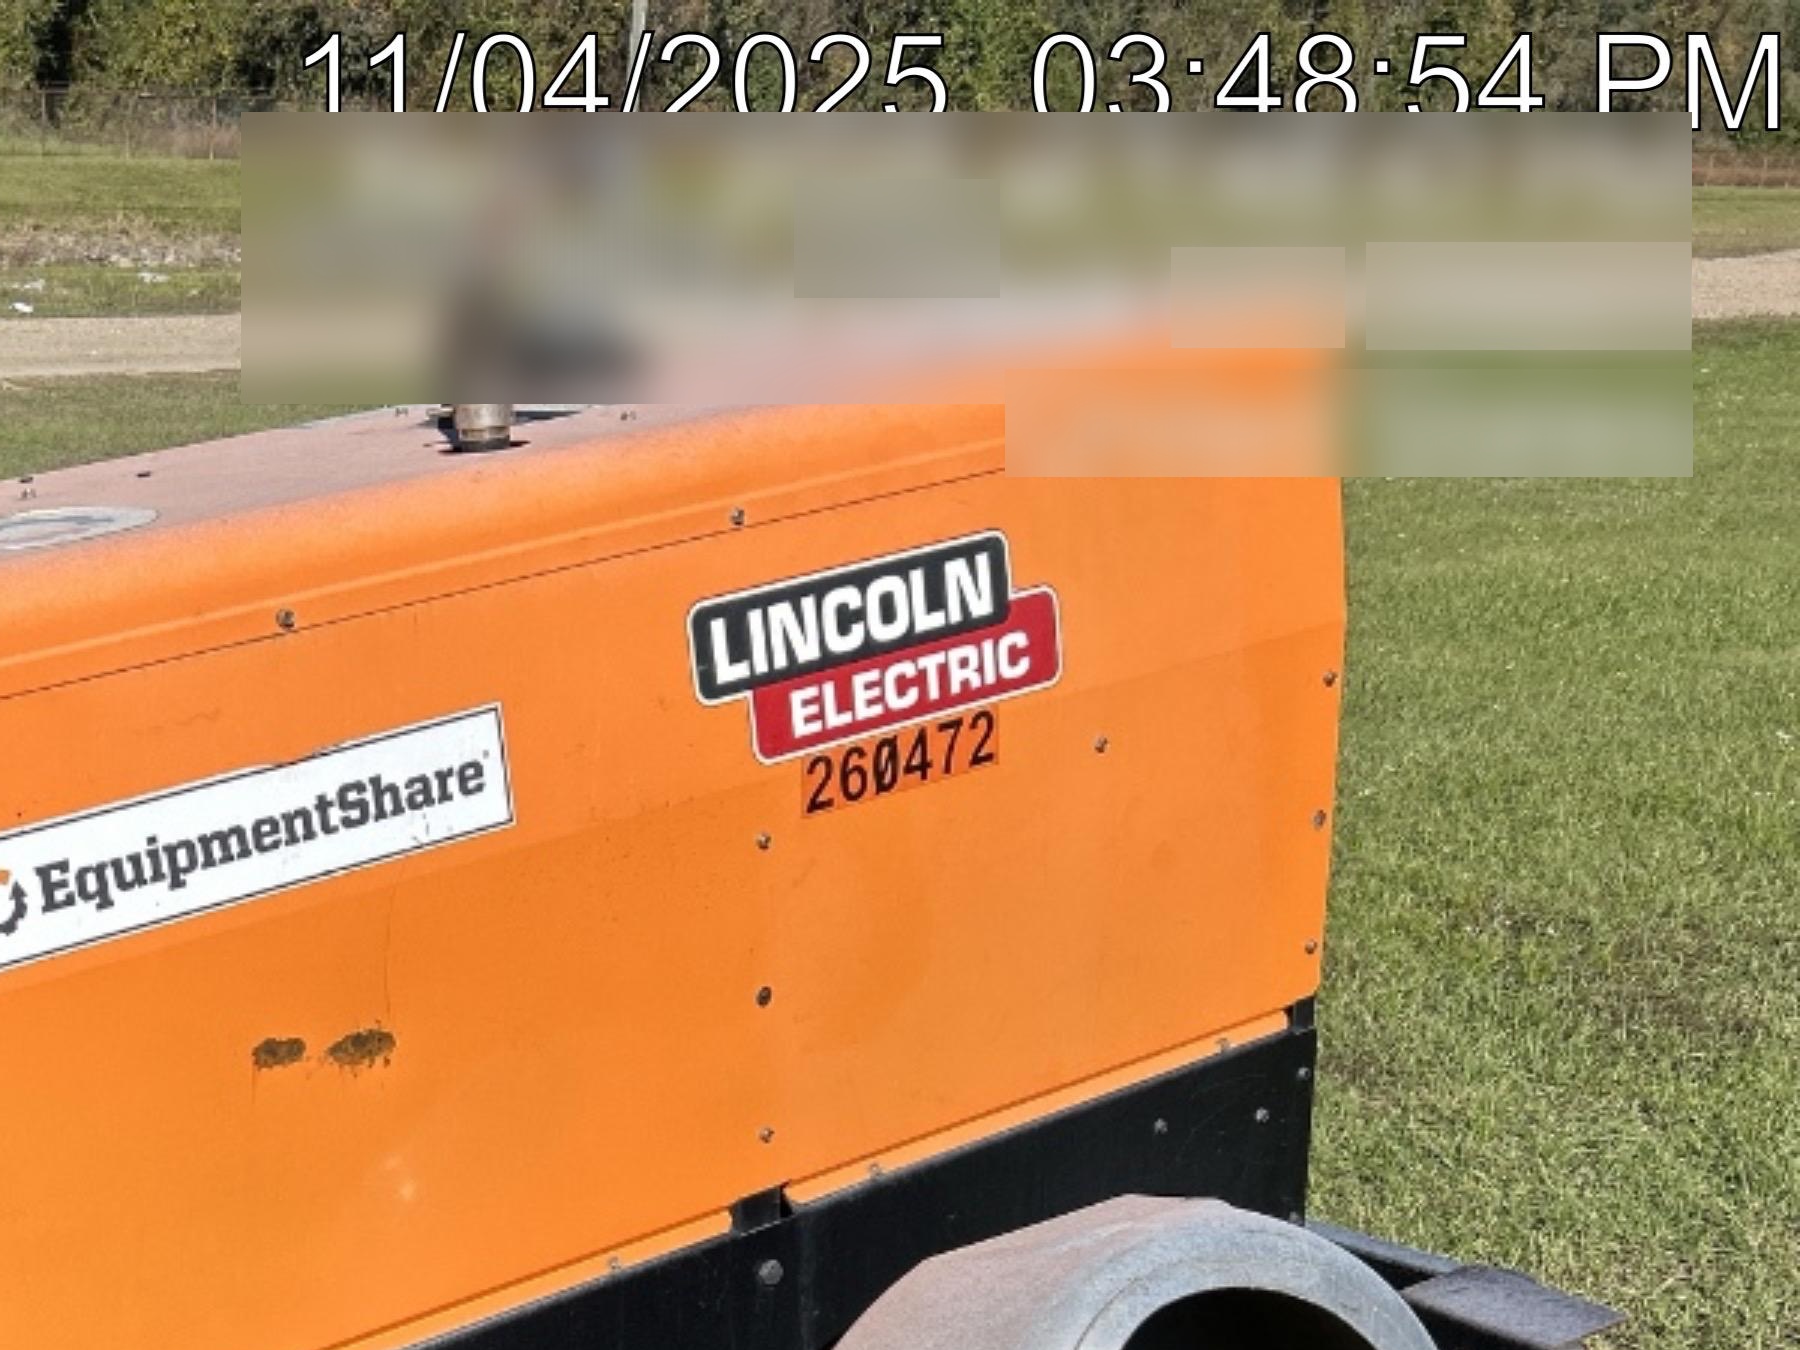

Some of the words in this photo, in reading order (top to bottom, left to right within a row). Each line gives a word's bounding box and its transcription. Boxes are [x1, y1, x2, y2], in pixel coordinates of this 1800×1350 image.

[710, 551, 994, 686] LINCOLN
[789, 631, 1032, 739] ELECTRIC
[806, 710, 995, 814] 260472
[34, 756, 487, 911] EquipmentShare
